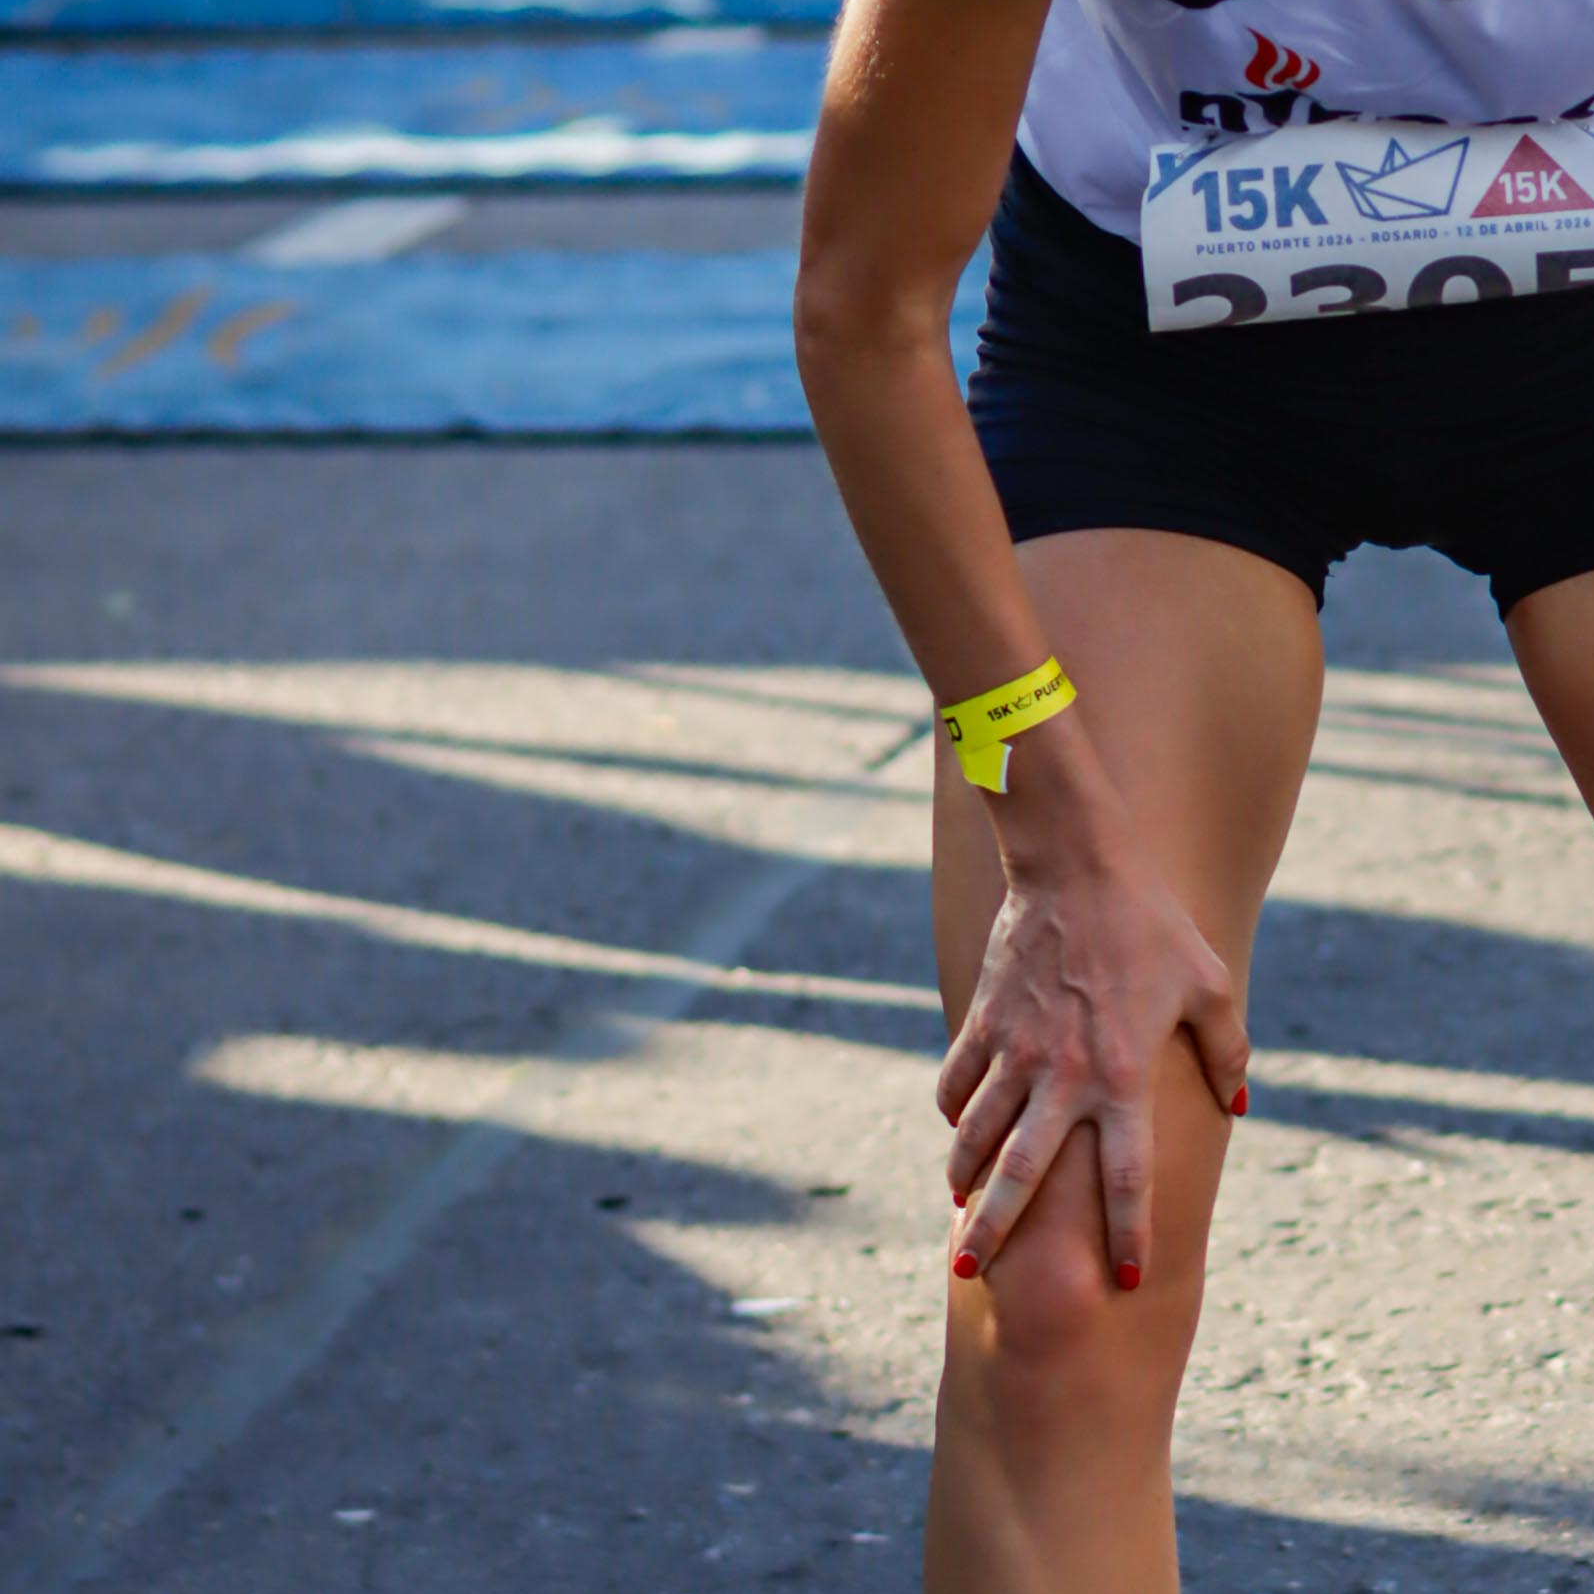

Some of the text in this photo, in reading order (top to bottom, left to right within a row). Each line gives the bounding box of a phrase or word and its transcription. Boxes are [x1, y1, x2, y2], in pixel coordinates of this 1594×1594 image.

[1192, 163, 1329, 233] 15K
[1498, 169, 1568, 204] 15K
[1196, 240, 1255, 256] PUERTO
[1262, 237, 1311, 252] NORTE
[1317, 234, 1353, 248] 2026
[1371, 228, 1438, 243] ROSARIO
[1456, 225, 1473, 238] 12
[1479, 224, 1497, 236] DE
[1504, 219, 1548, 234] ABRIL
[1555, 217, 1592, 231] 2026
[987, 703, 1013, 722] 15K
